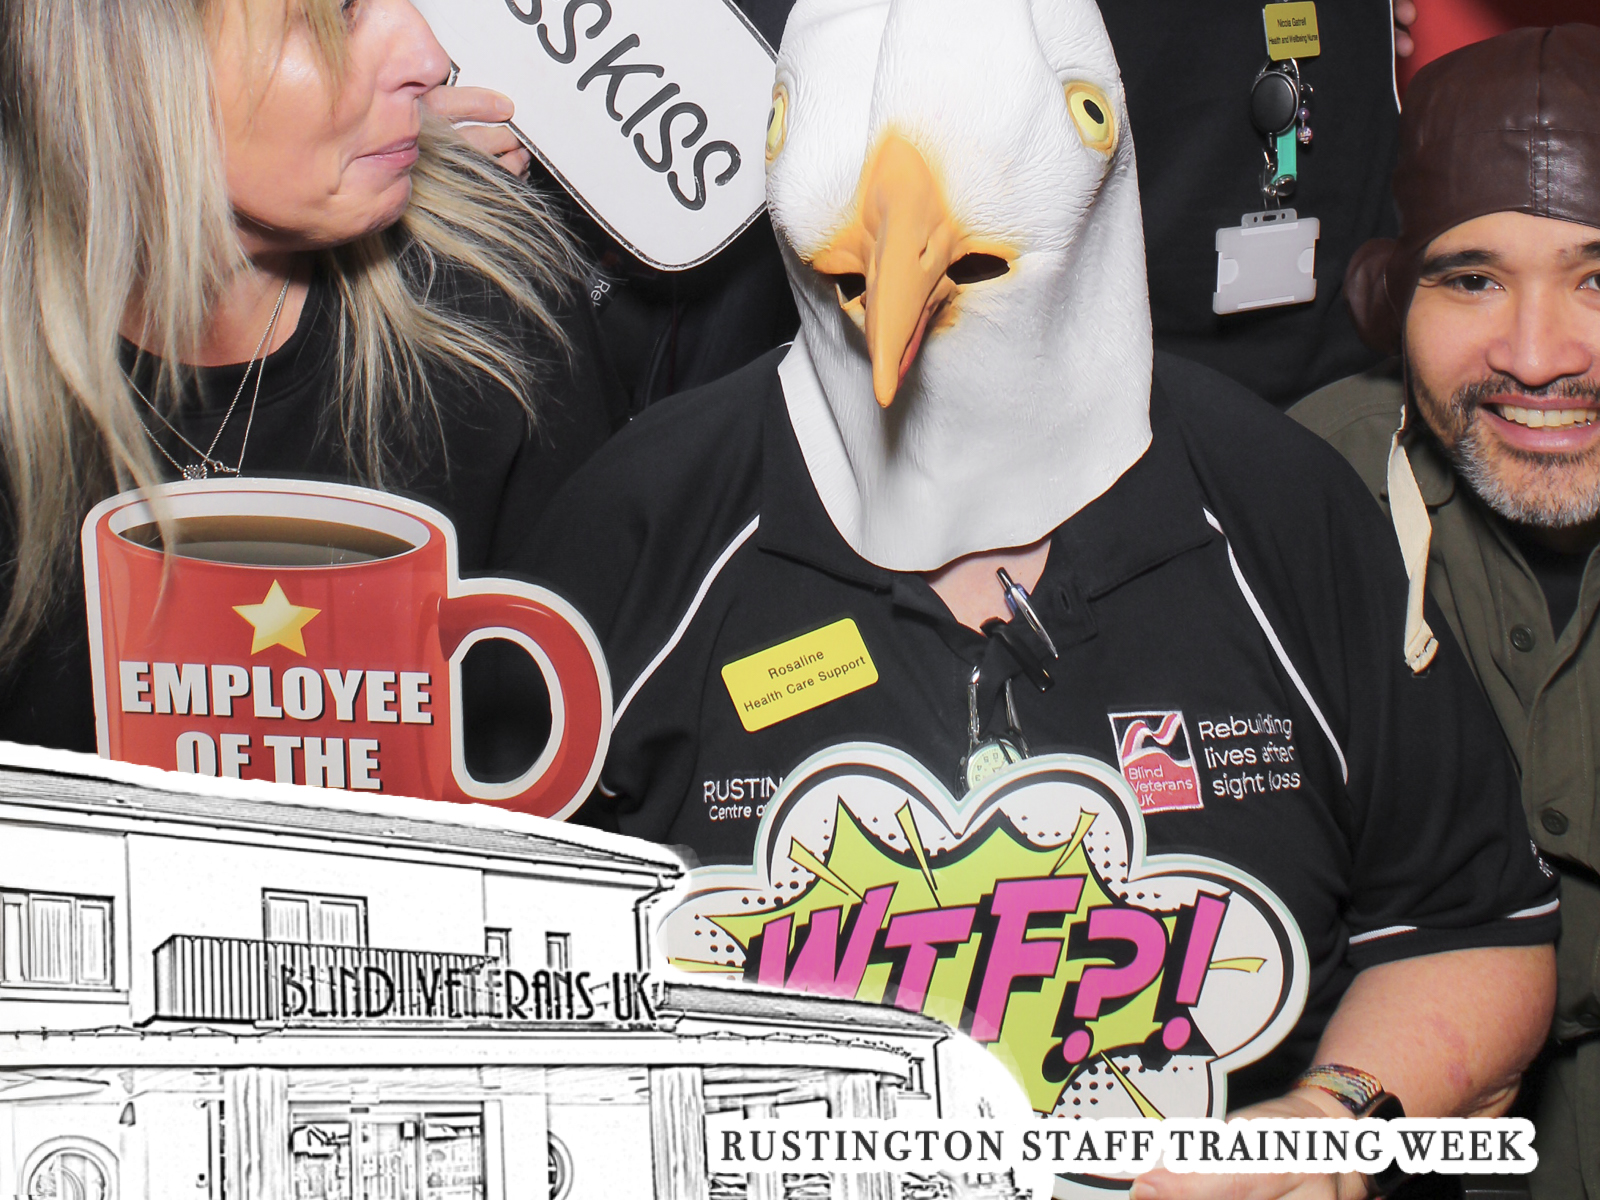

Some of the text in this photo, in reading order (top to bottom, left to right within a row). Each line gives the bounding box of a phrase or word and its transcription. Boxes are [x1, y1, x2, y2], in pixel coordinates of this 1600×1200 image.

[767, 650, 825, 680] Rosaline
[118, 660, 433, 724] EMPLOYEE
[743, 655, 867, 712] Health Care Support
[1198, 713, 1293, 741] Rebuilding
[175, 731, 382, 790] OF THE
[1204, 741, 1295, 769] lives after
[1128, 764, 1164, 780] Blind
[1130, 777, 1194, 794] Veterans
[1212, 770, 1301, 800] sight loss
[709, 803, 752, 821] Centre
